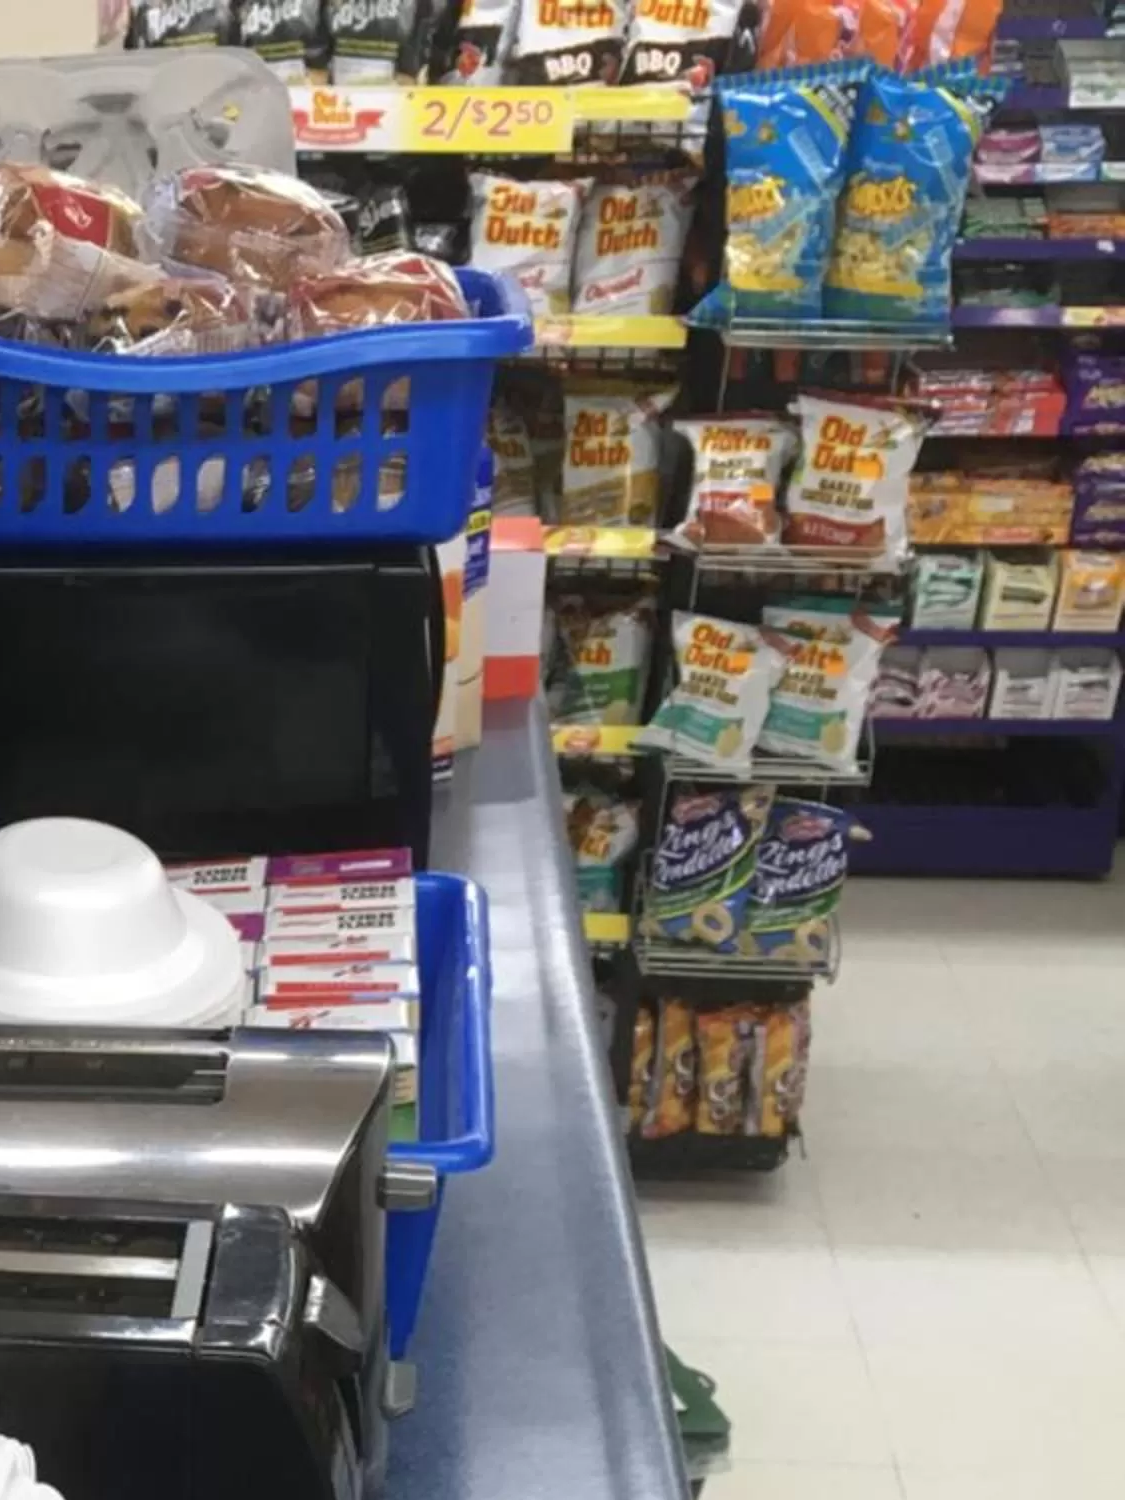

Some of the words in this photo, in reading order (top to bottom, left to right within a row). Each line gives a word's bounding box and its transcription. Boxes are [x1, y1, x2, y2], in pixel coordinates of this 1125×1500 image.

[545, 53, 592, 81] BBQ
[635, 51, 681, 74] BBQ
[599, 196, 638, 224] Old
[486, 214, 560, 249] Dutch
[597, 223, 659, 258] Dutch
[820, 415, 868, 446] Old
[812, 443, 884, 481] Dut
[693, 623, 735, 647] Old
